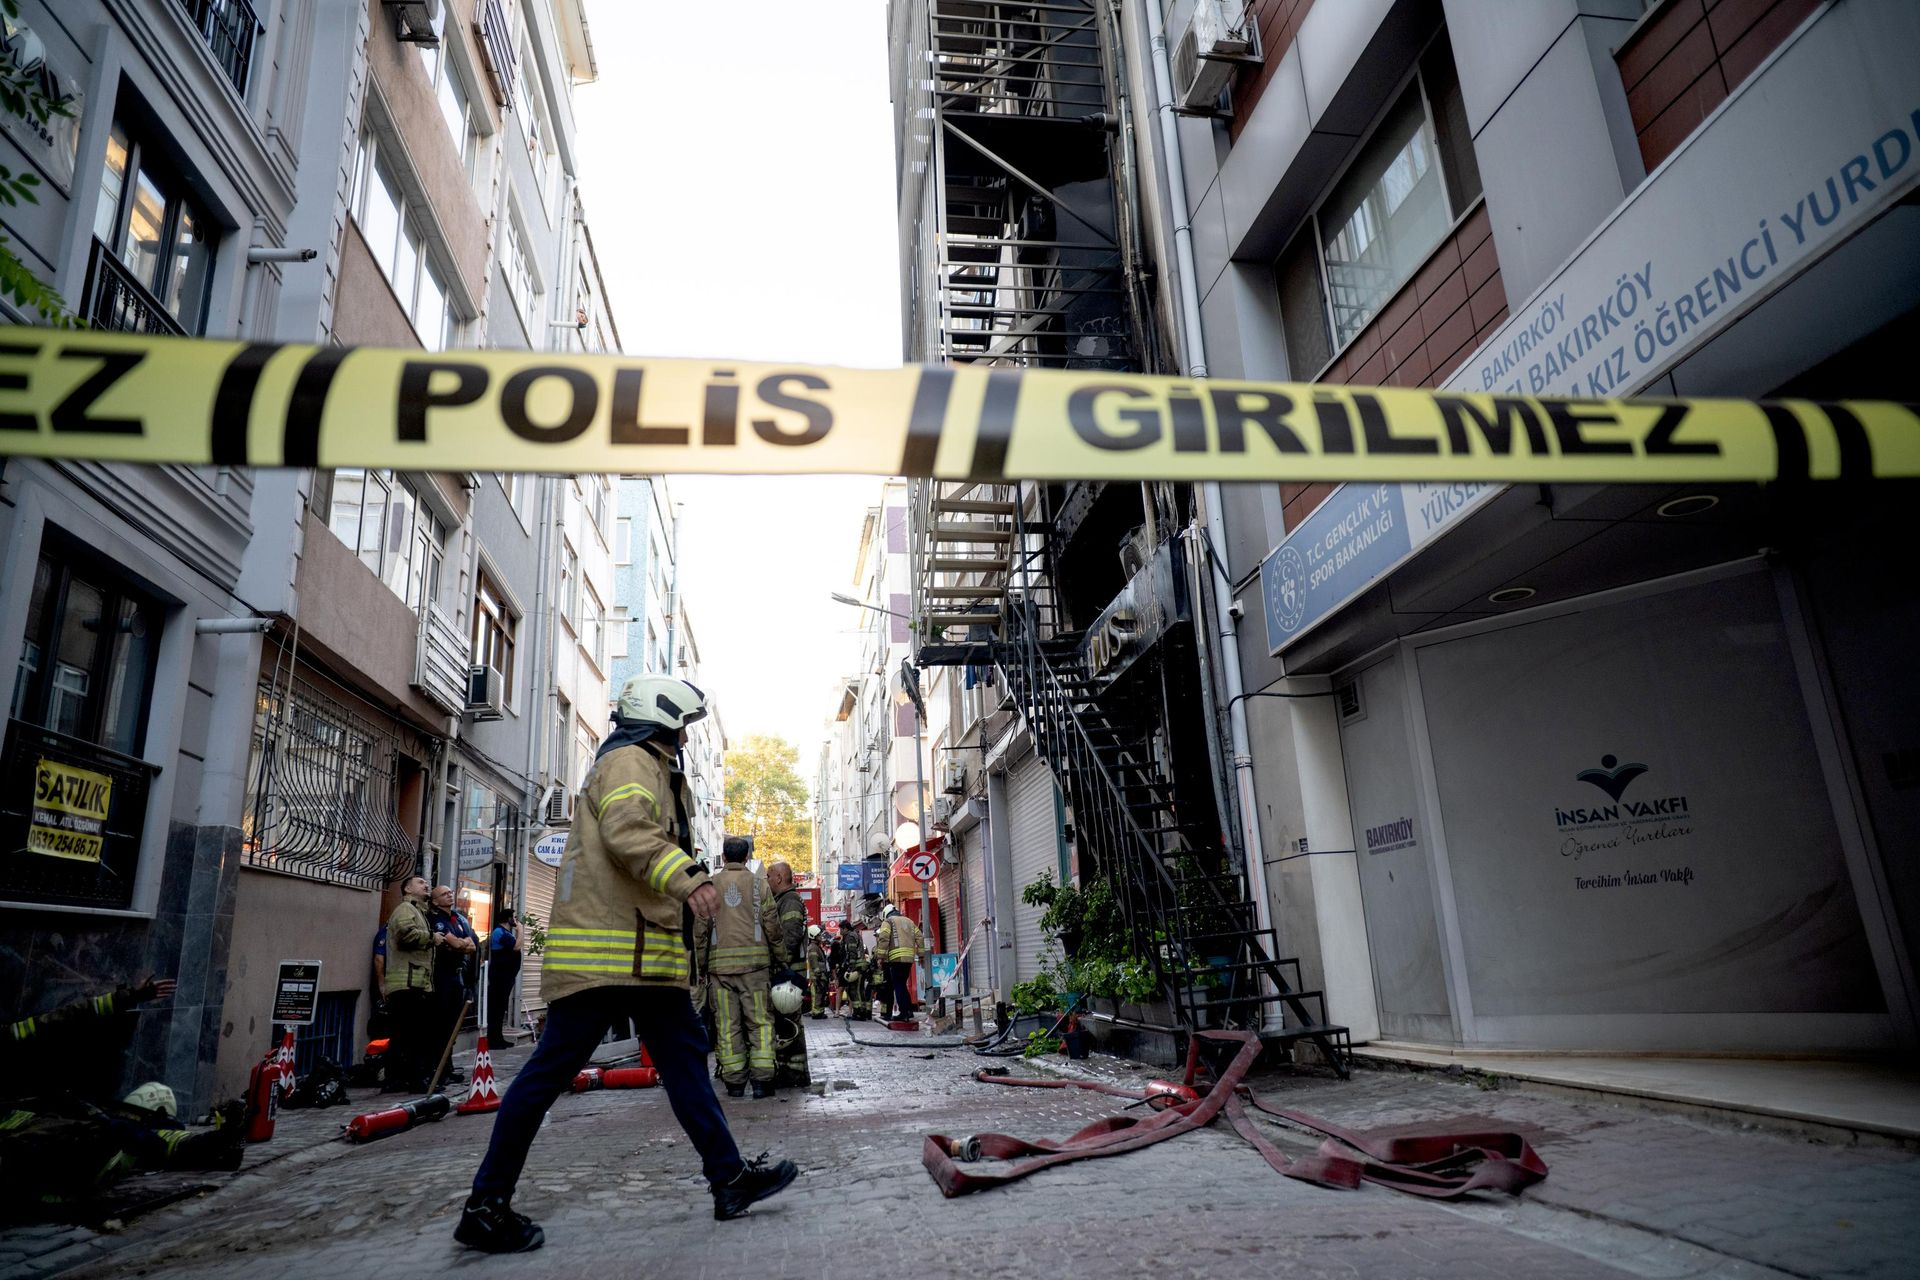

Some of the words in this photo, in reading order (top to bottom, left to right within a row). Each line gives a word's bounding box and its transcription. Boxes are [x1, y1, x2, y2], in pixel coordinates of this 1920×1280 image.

[1587, 346, 1631, 398] KIZ
[1634, 218, 1778, 364] ÖĞRENCİ
[1780, 108, 1920, 245] YURD
[1481, 293, 1565, 391] BAKIRKÖY
[1528, 260, 1652, 396] BAKIRKÖY
[394, 360, 834, 447] POLİS
[1065, 382, 1722, 457] GİRİLMEZ
[1306, 541, 1325, 567] T.C.
[1326, 498, 1371, 548] GENÇLİK
[1372, 484, 1389, 509] VE
[1310, 560, 1335, 590] SPOR
[1336, 509, 1393, 569] BAKANLIĞI
[36, 770, 108, 814] SATILIK
[1555, 805, 1619, 826] İNSAN
[1623, 797, 1688, 817] VAKFI
[34, 810, 58, 826] KEMAL
[1366, 816, 1413, 849] BAKIRKÖY
[30, 829, 55, 850] 0532
[54, 834, 74, 853] 254
[73, 837, 87, 856] 86
[87, 840, 99, 858] 77
[538, 845, 551, 854] CAM
[1575, 875, 1622, 890] Tercihim
[1624, 869, 1658, 887] İnsan
[1660, 866, 1695, 887] Vakfı
